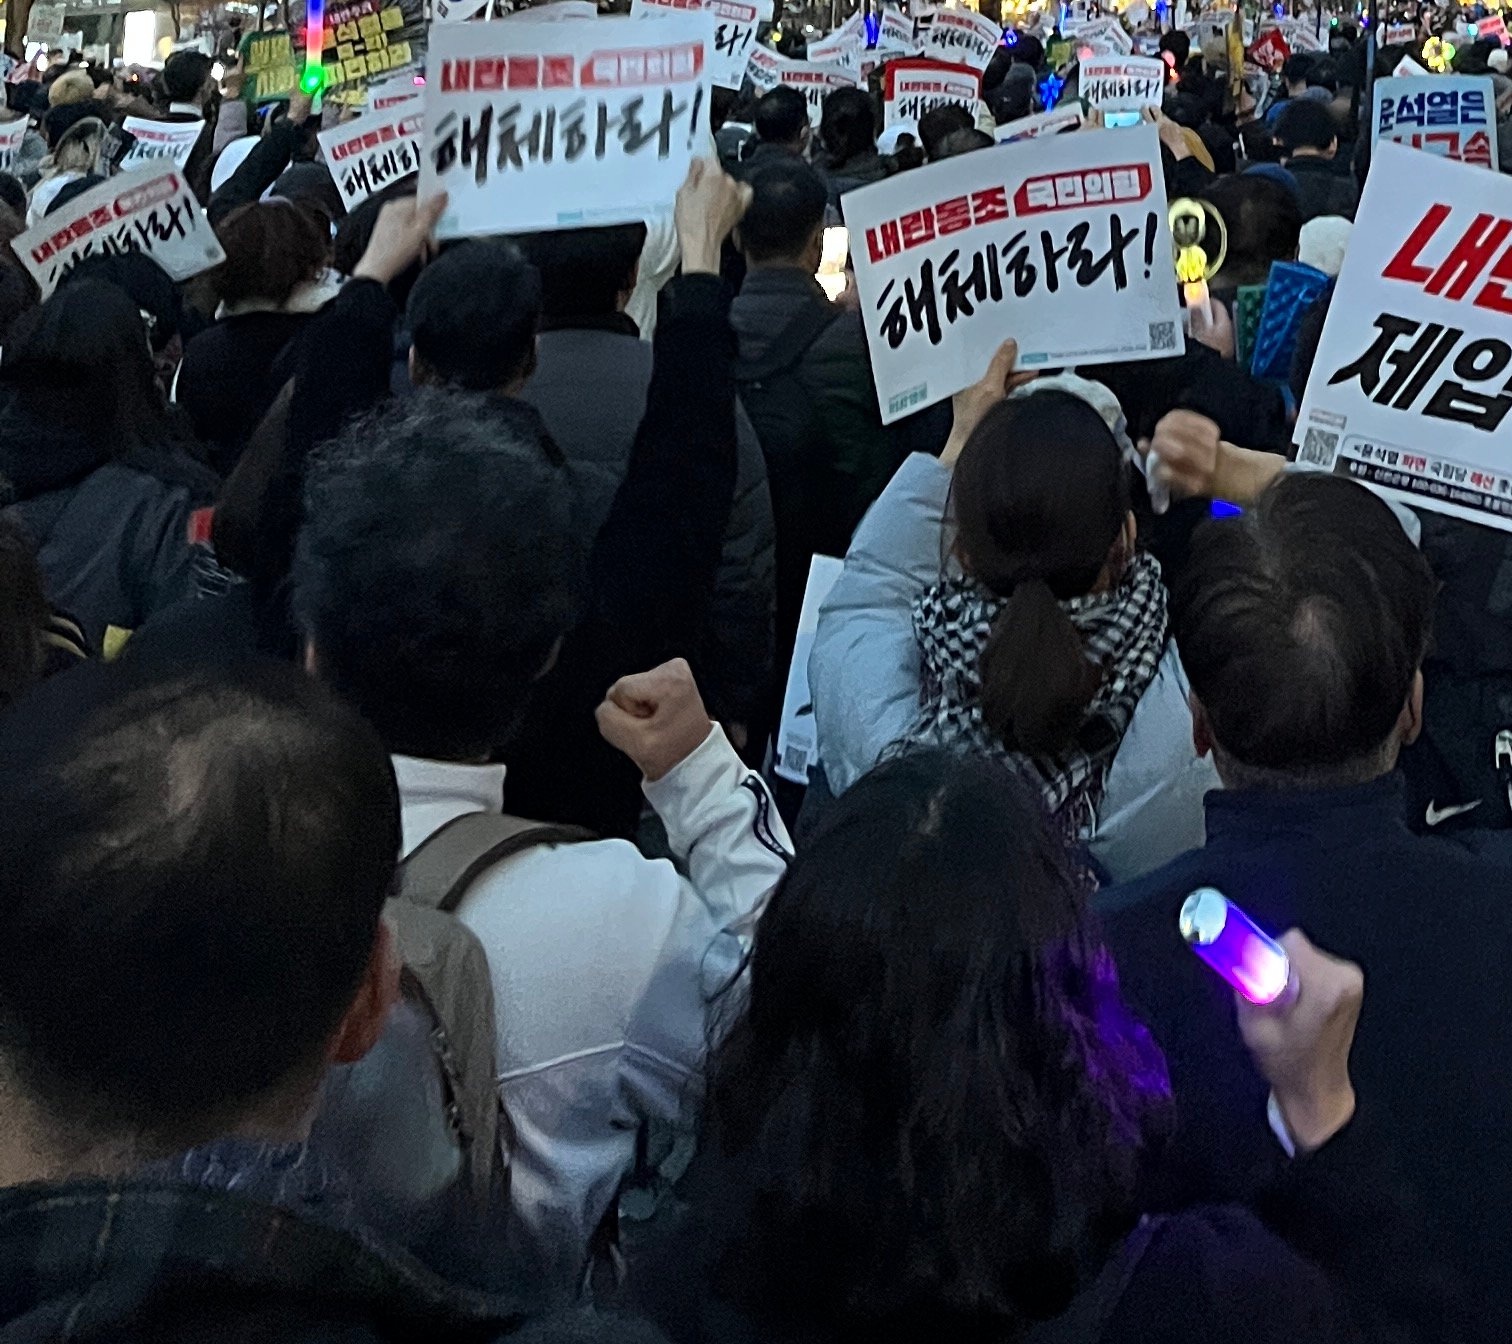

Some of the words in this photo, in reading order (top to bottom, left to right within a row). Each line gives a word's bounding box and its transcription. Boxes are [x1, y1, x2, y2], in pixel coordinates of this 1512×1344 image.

[431, 81, 704, 189] 해체하라!
[1378, 90, 1487, 134] 윤석열은
[865, 185, 1010, 265] 내란동조
[1027, 167, 1141, 209] 국민의힘
[876, 211, 1158, 350] 해체하라!
